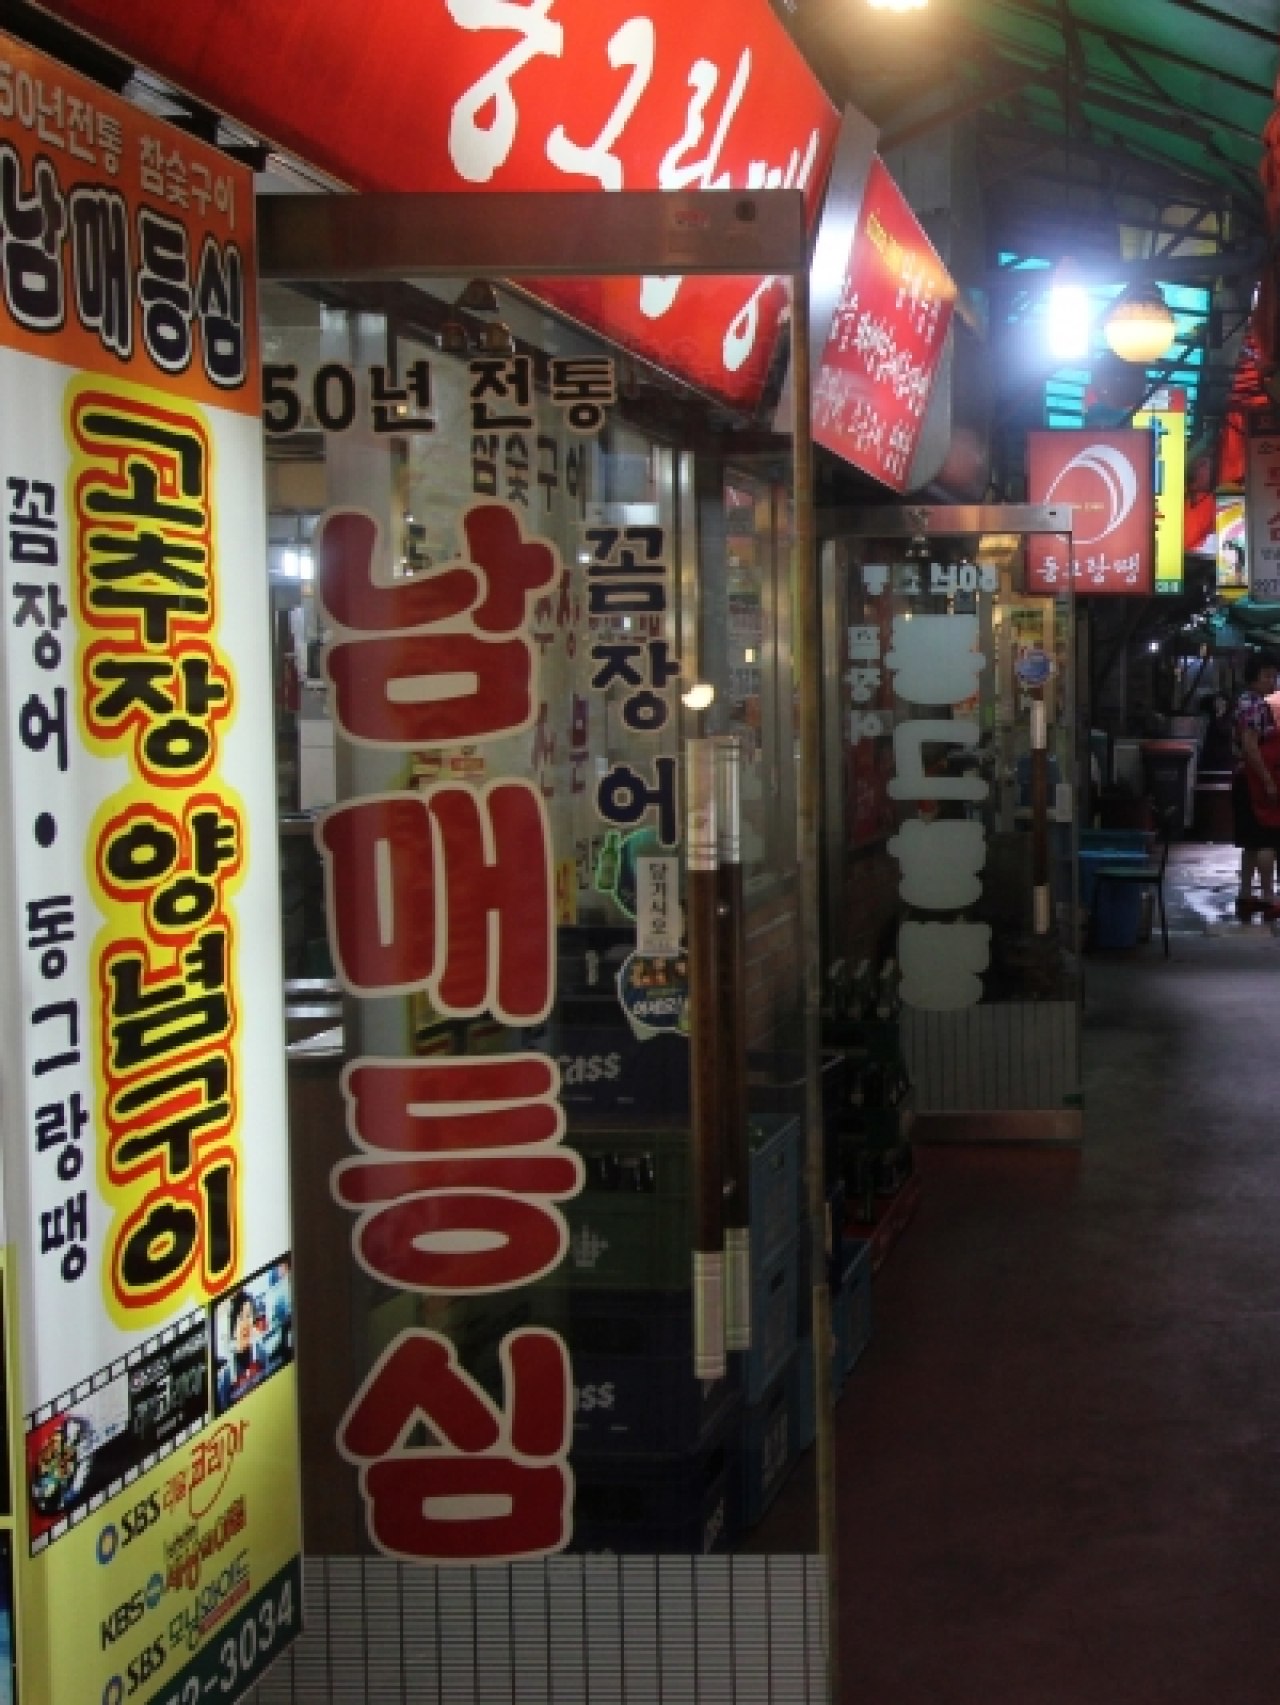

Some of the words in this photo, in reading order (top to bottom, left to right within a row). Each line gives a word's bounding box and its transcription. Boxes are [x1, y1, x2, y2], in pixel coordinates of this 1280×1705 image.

[0, 142, 246, 390] 남매등심
[470, 358, 615, 433] 전통
[6, 476, 69, 772] 꼼장어
[1037, 552, 1140, 584] 동그랑땡
[587, 527, 680, 845] 꼼장어
[27, 894, 89, 1283] 동그랑땡
[318, 503, 584, 1557] 남매등심
[121, 1488, 162, 1548] SBS
[99, 1588, 146, 1652] KBS
[126, 1632, 167, 1697] SBS
